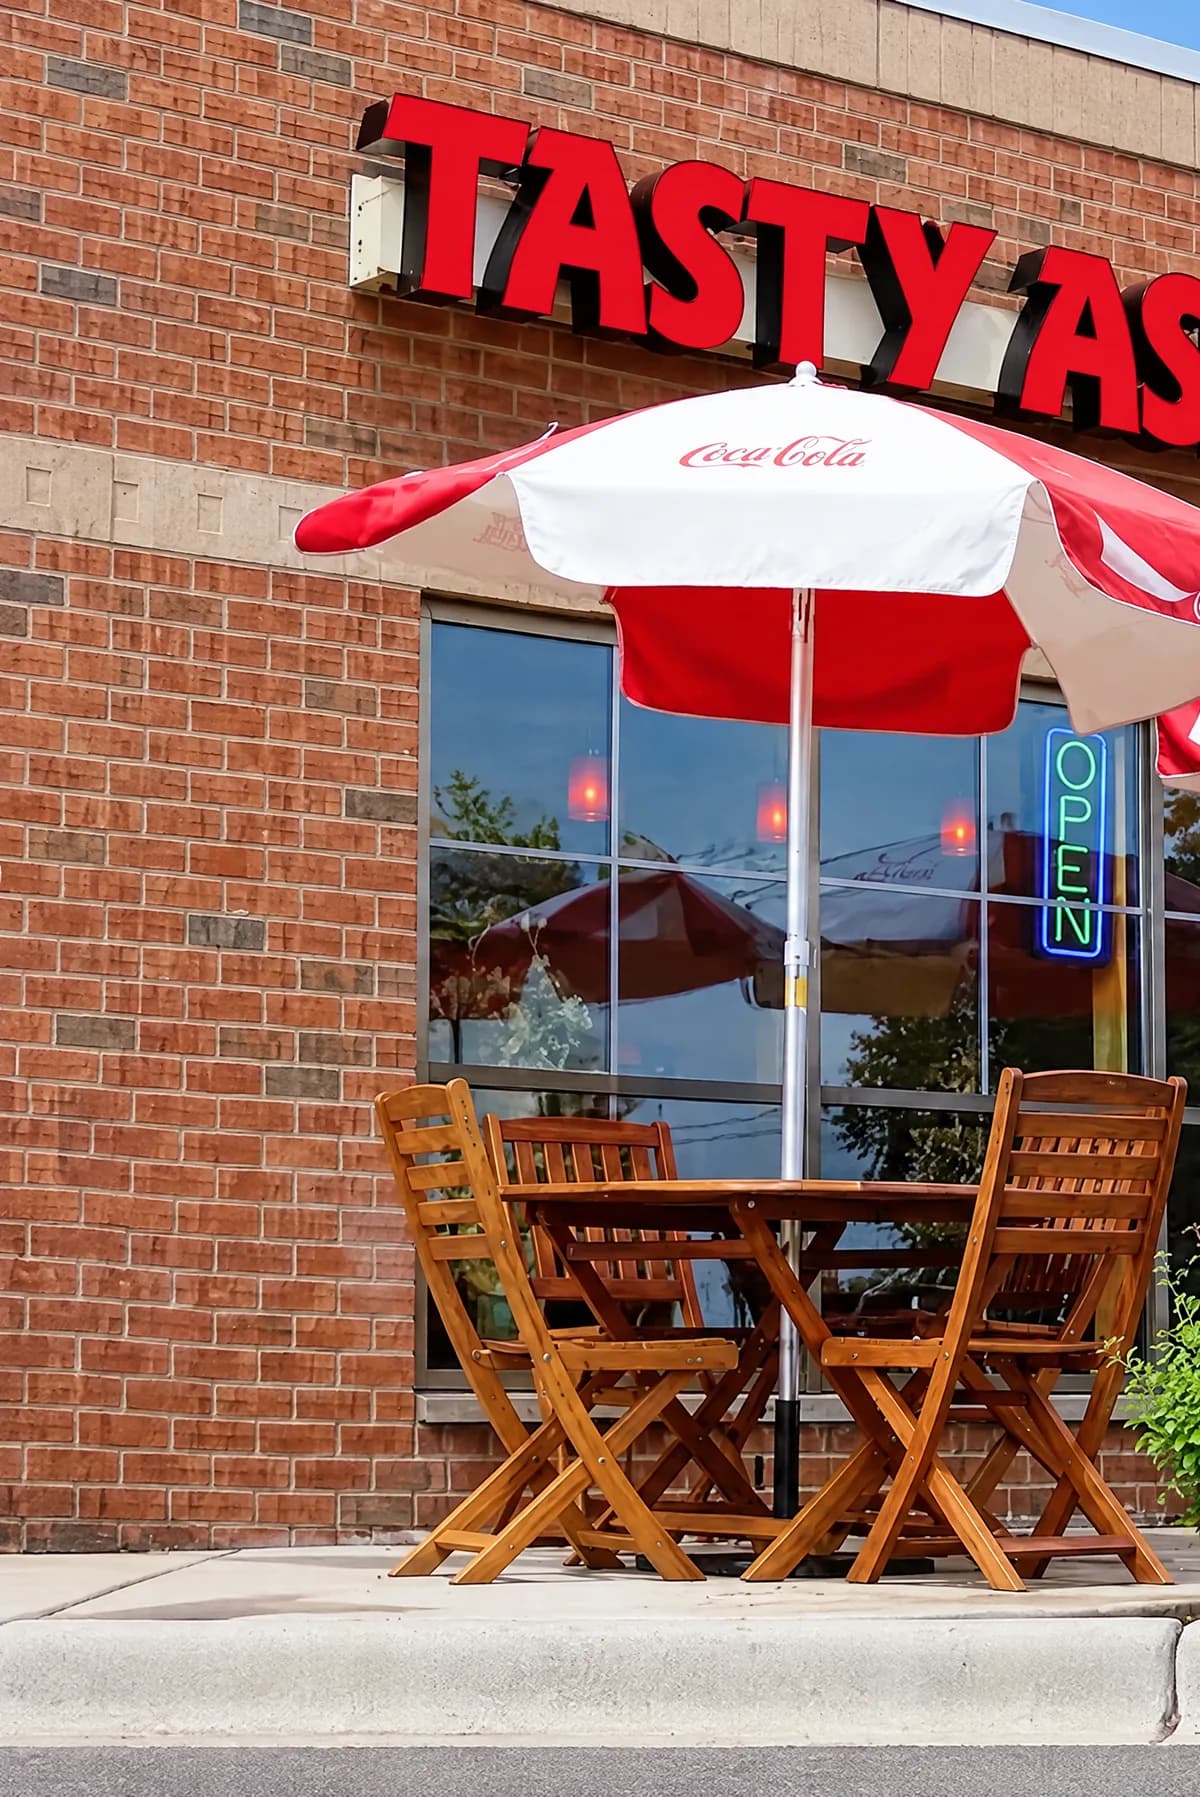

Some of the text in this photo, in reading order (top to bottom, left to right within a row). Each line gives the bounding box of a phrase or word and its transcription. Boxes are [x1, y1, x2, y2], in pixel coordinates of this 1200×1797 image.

[383, 92, 999, 391] TASTY
[679, 435, 873, 468] Coca-Cola
[1055, 740, 1097, 945] OPEN
